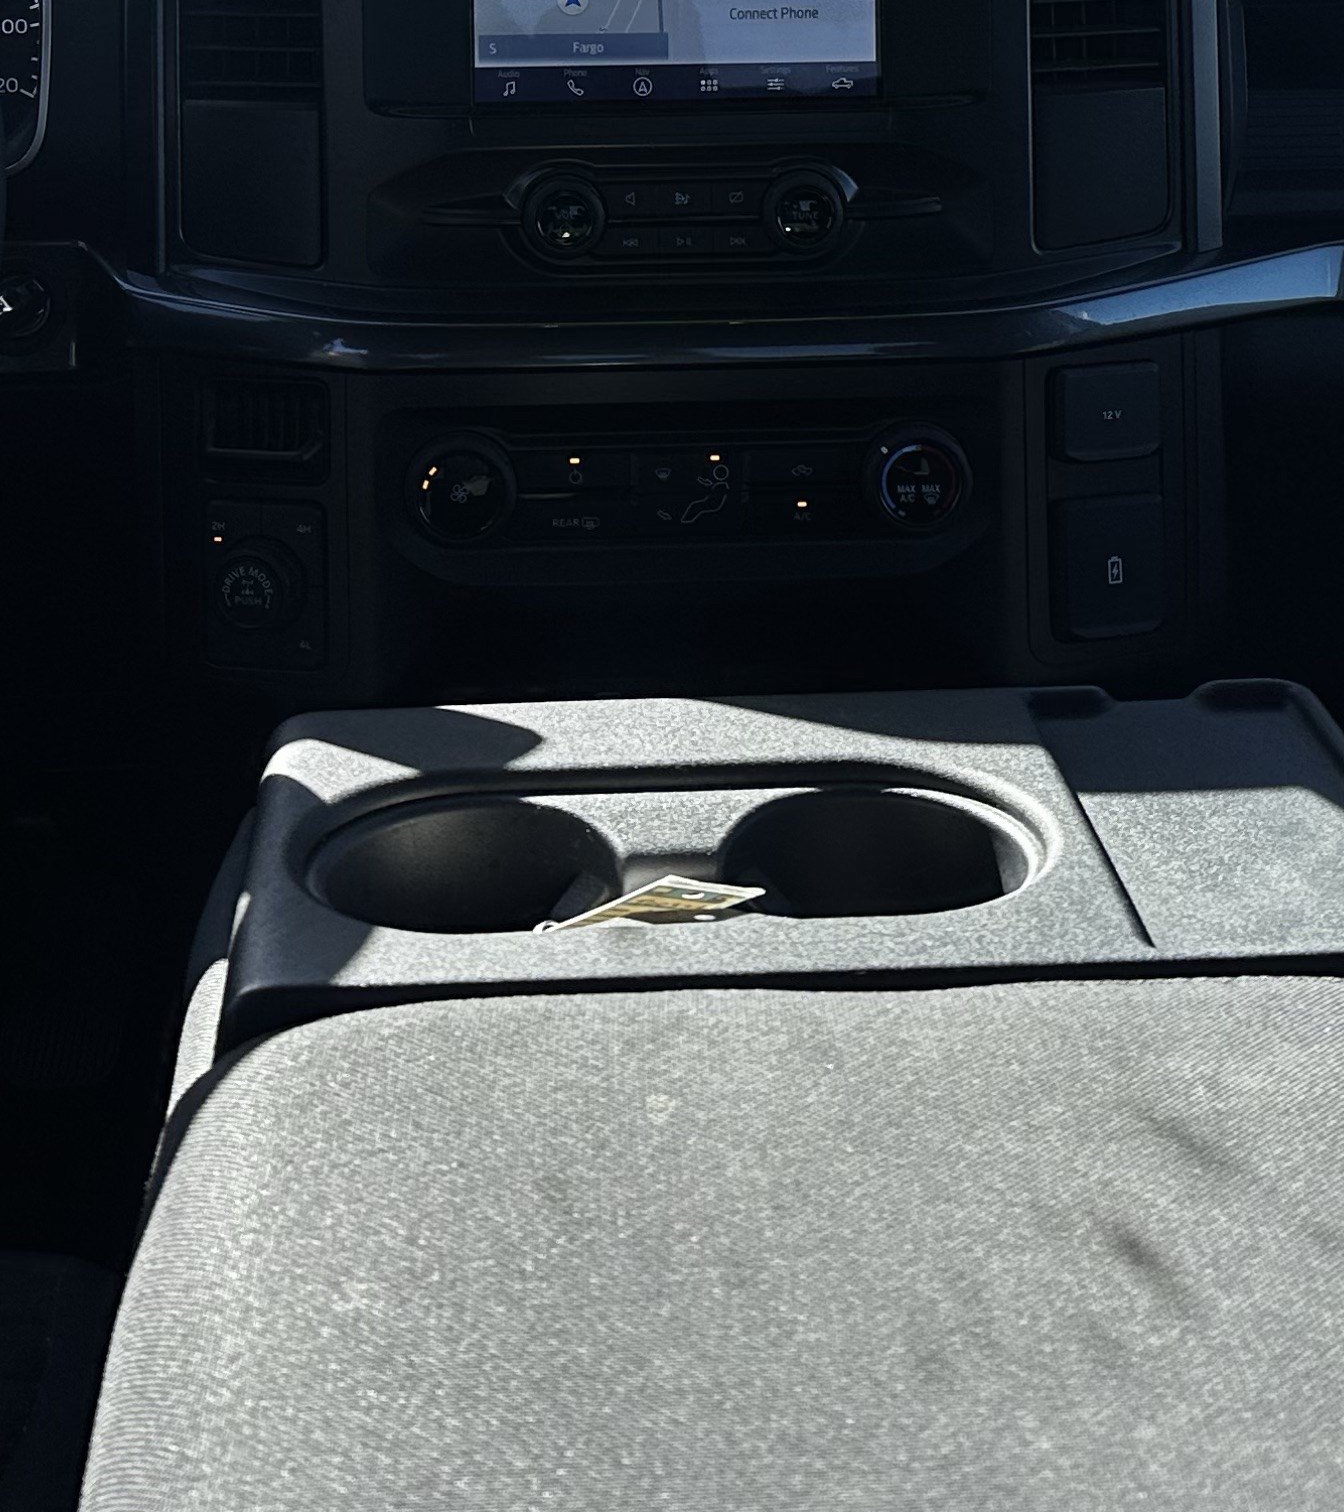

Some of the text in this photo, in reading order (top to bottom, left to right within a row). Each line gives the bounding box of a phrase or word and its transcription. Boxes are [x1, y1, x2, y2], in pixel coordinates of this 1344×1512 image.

[729, 6, 819, 21] Connect Phone
[488, 41, 605, 56] S Fargo
[1102, 410, 1122, 420] 12V
[552, 516, 581, 529] REAR
[222, 566, 274, 596] DRIVE MODE
[234, 595, 263, 606] PUSH
